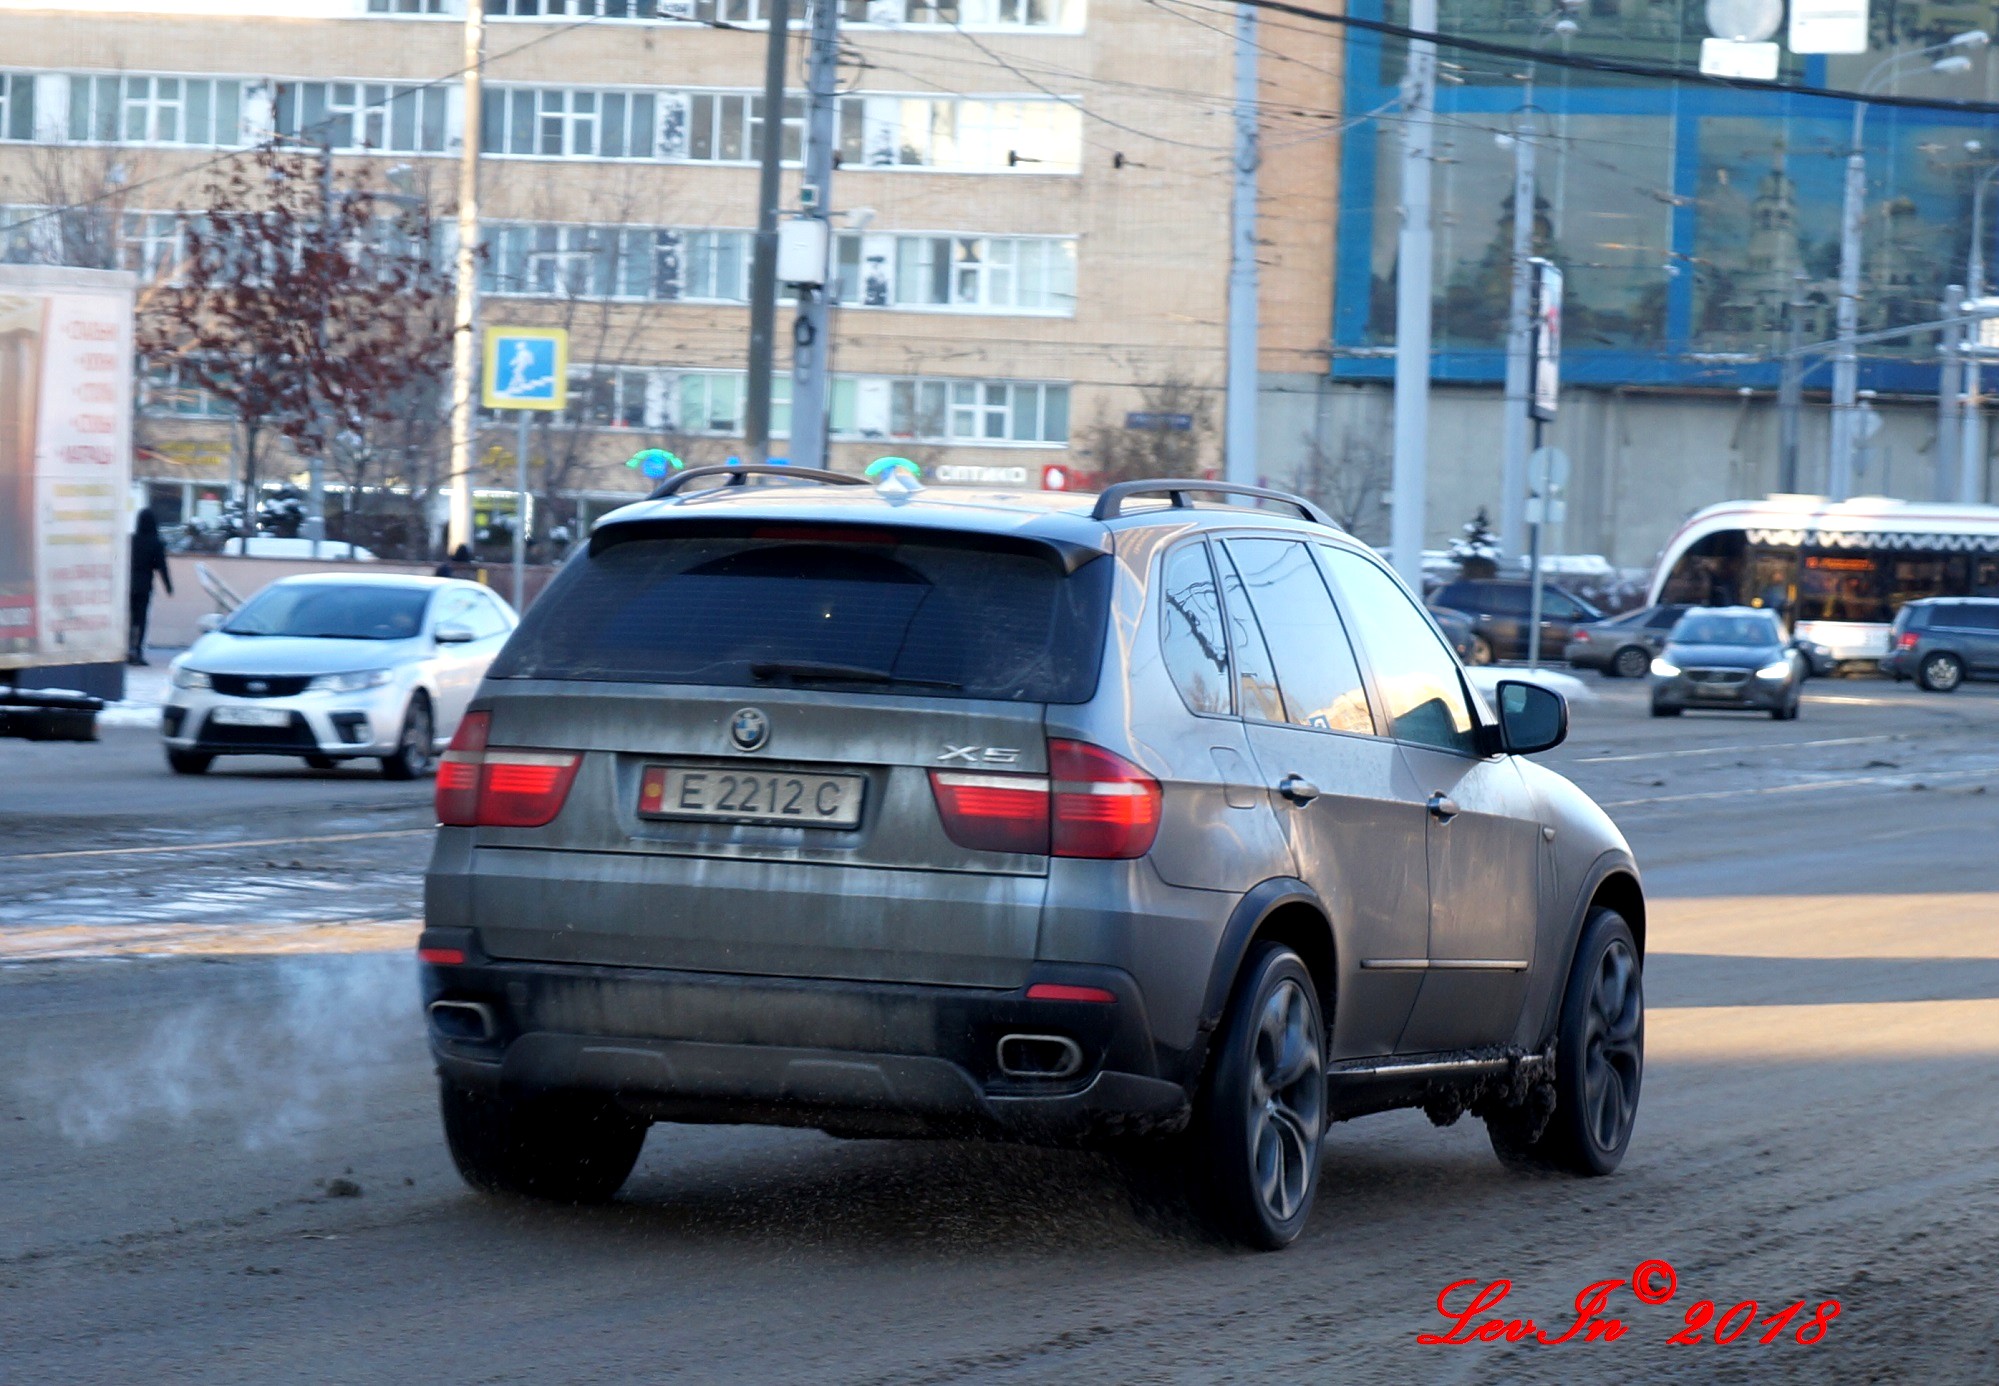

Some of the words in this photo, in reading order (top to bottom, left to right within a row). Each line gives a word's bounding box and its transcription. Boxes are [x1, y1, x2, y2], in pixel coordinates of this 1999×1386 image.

[936, 744, 1021, 764] X5
[679, 773, 707, 809] E
[716, 775, 804, 814] 2212
[816, 781, 840, 816] C
